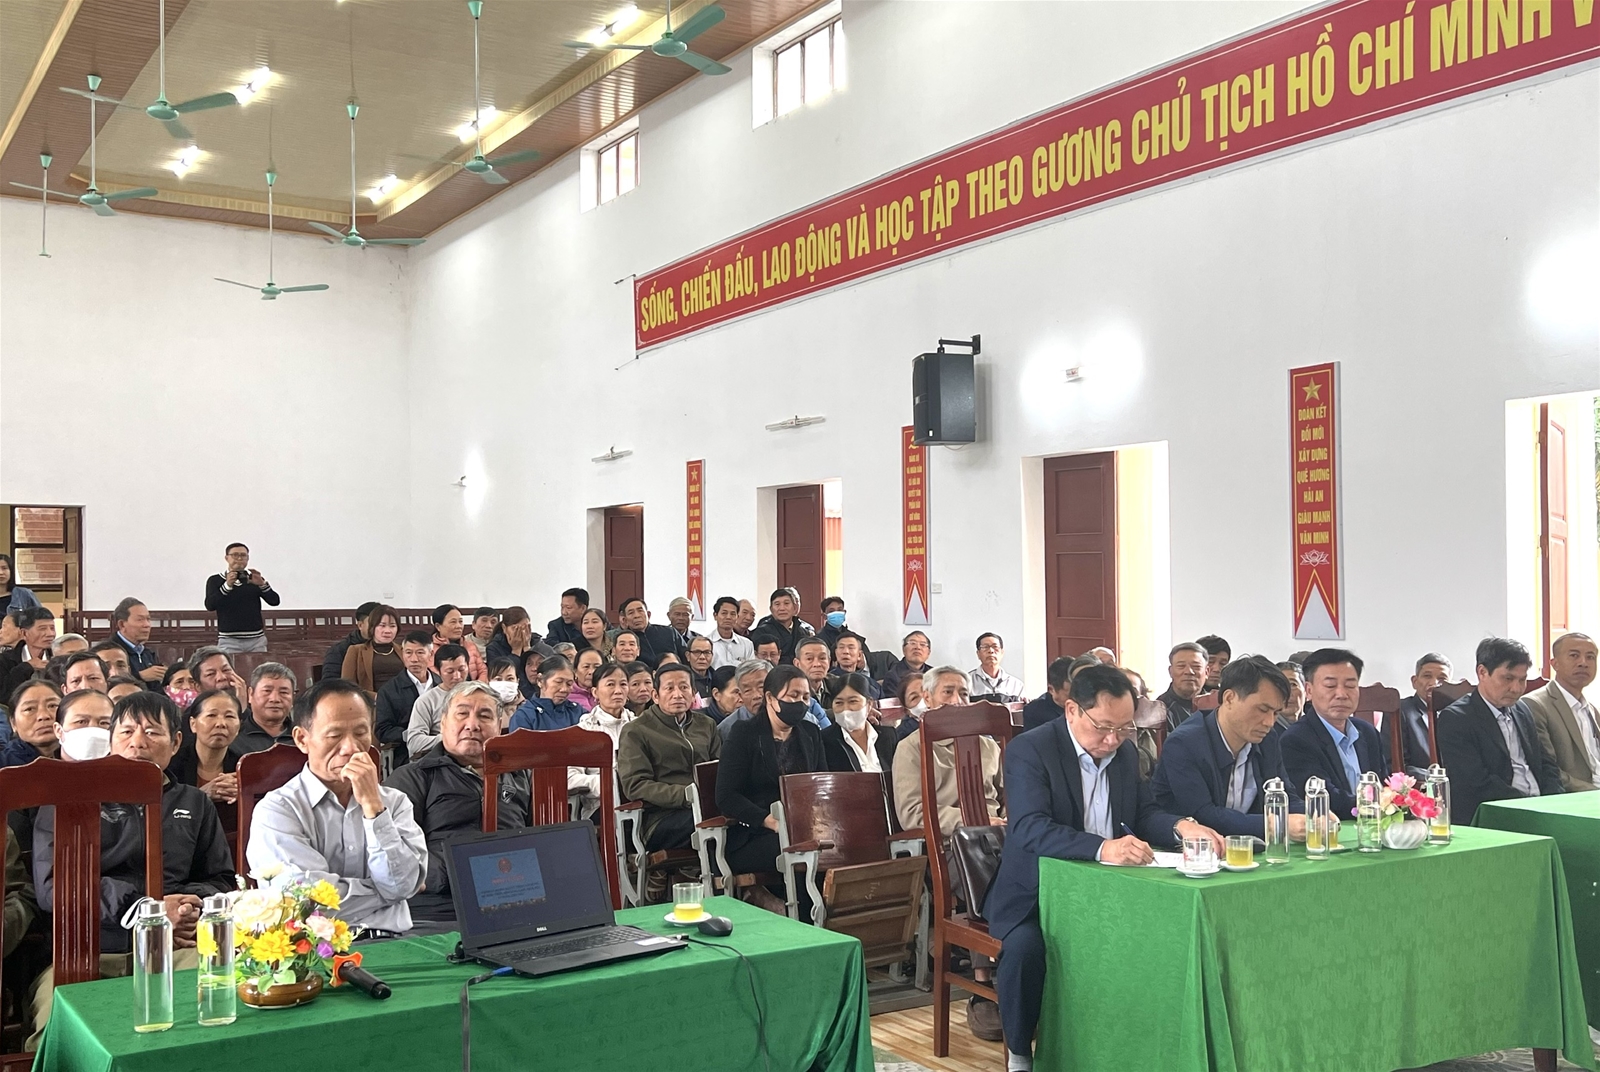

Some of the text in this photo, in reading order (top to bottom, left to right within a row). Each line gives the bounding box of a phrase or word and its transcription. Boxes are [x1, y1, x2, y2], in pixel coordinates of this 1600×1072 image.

[641, 280, 678, 332] SỐNG,
[681, 258, 721, 318] CHIẾN
[725, 245, 758, 303] ĐẤU,
[762, 244, 791, 287] LAO
[795, 223, 841, 284] ĐỘNG
[846, 203, 870, 260] VÀ
[875, 196, 914, 256] HỌC
[920, 175, 960, 241] TẬP
[967, 154, 1023, 220] THEO
[1032, 120, 1121, 199] GƯƠNG
[1131, 76, 1191, 165] CHỦ
[1201, 63, 1275, 152] TỊCH
[1287, 22, 1335, 117] HỒ
[1348, 0, 1415, 97] CHÍ
[1430, 0, 1551, 72] MINH
[1298, 402, 1326, 421] ĐOÀN KẾT
[1298, 447, 1327, 463] XÂY DỰNG
[1297, 468, 1330, 484] QUÊ HƯƠNG
[1303, 486, 1323, 502] HẢI AN
[1297, 510, 1330, 525] GIÀU MẠNH
[1299, 530, 1329, 544] VĂN MINH
